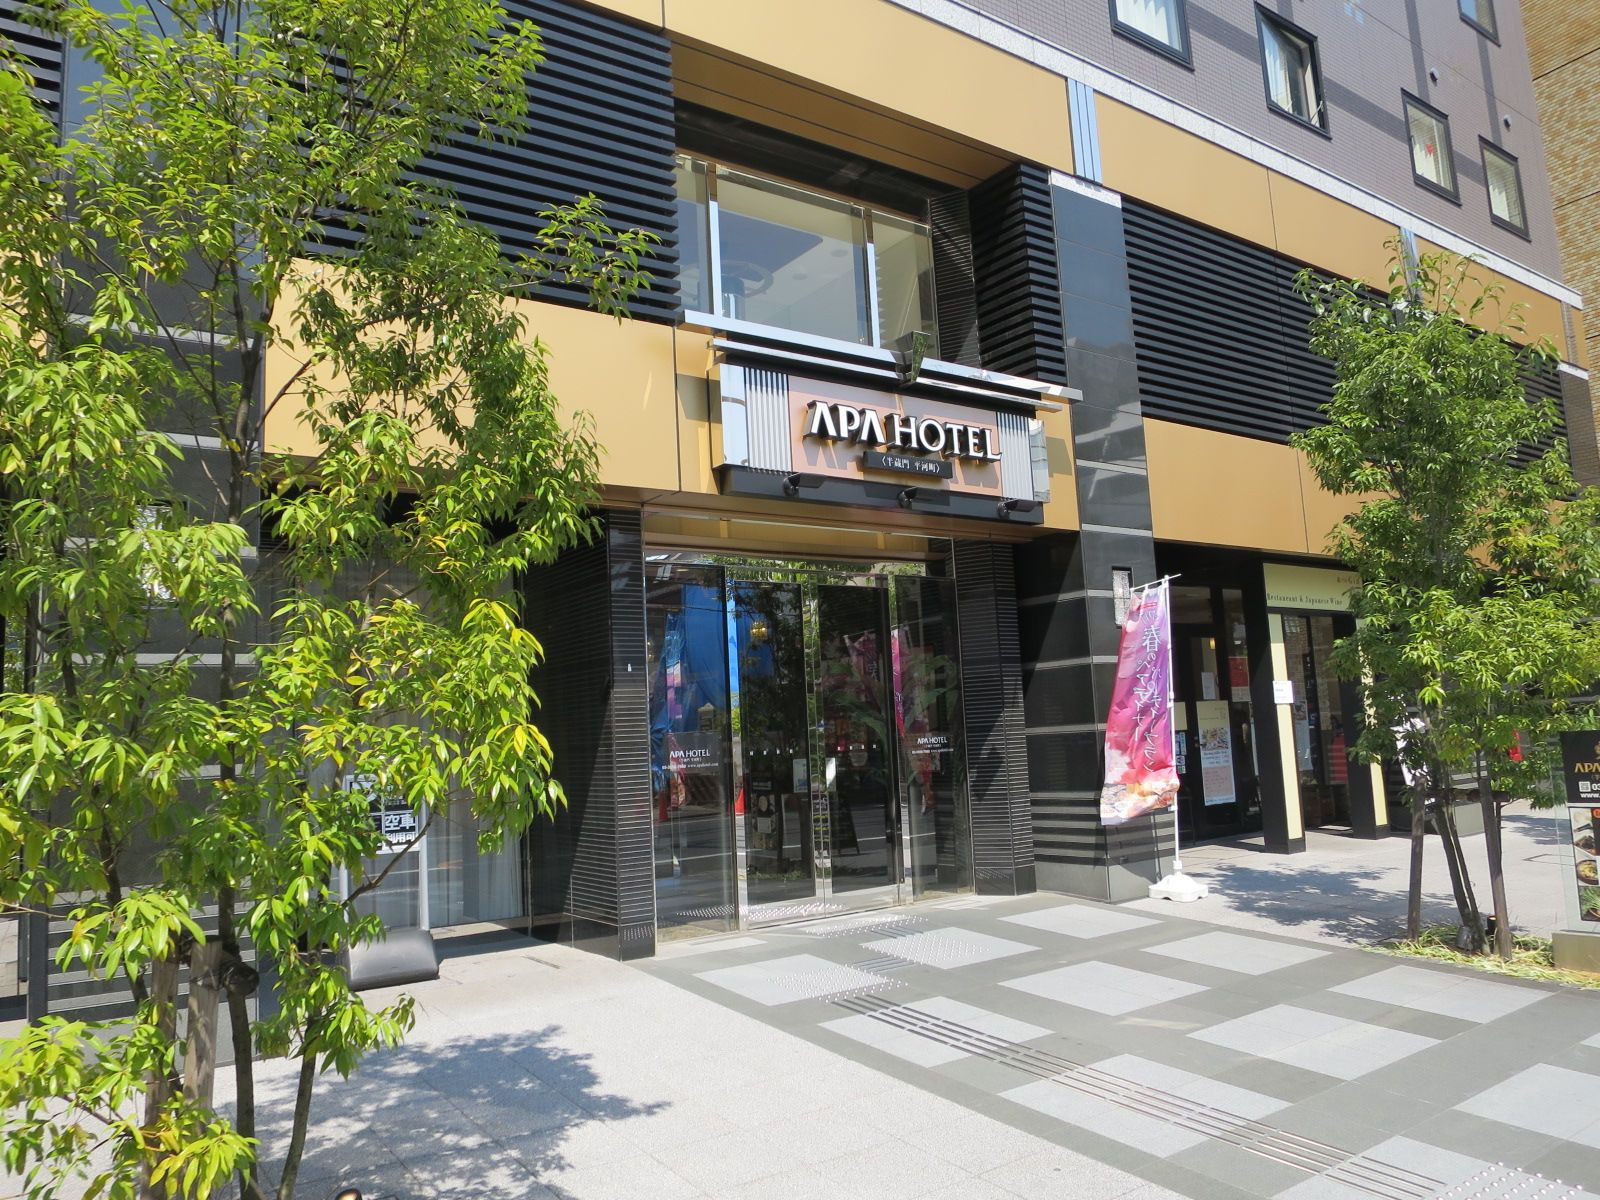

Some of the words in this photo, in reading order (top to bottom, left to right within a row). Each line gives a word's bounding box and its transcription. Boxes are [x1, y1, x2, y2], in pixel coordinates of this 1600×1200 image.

[805, 400, 887, 444] APA
[889, 413, 1003, 461] HOTEL
[930, 736, 948, 744] HOTEL
[670, 750, 685, 758] APA
[686, 749, 711, 758] HOTEL
[385, 813, 416, 831] 空車
